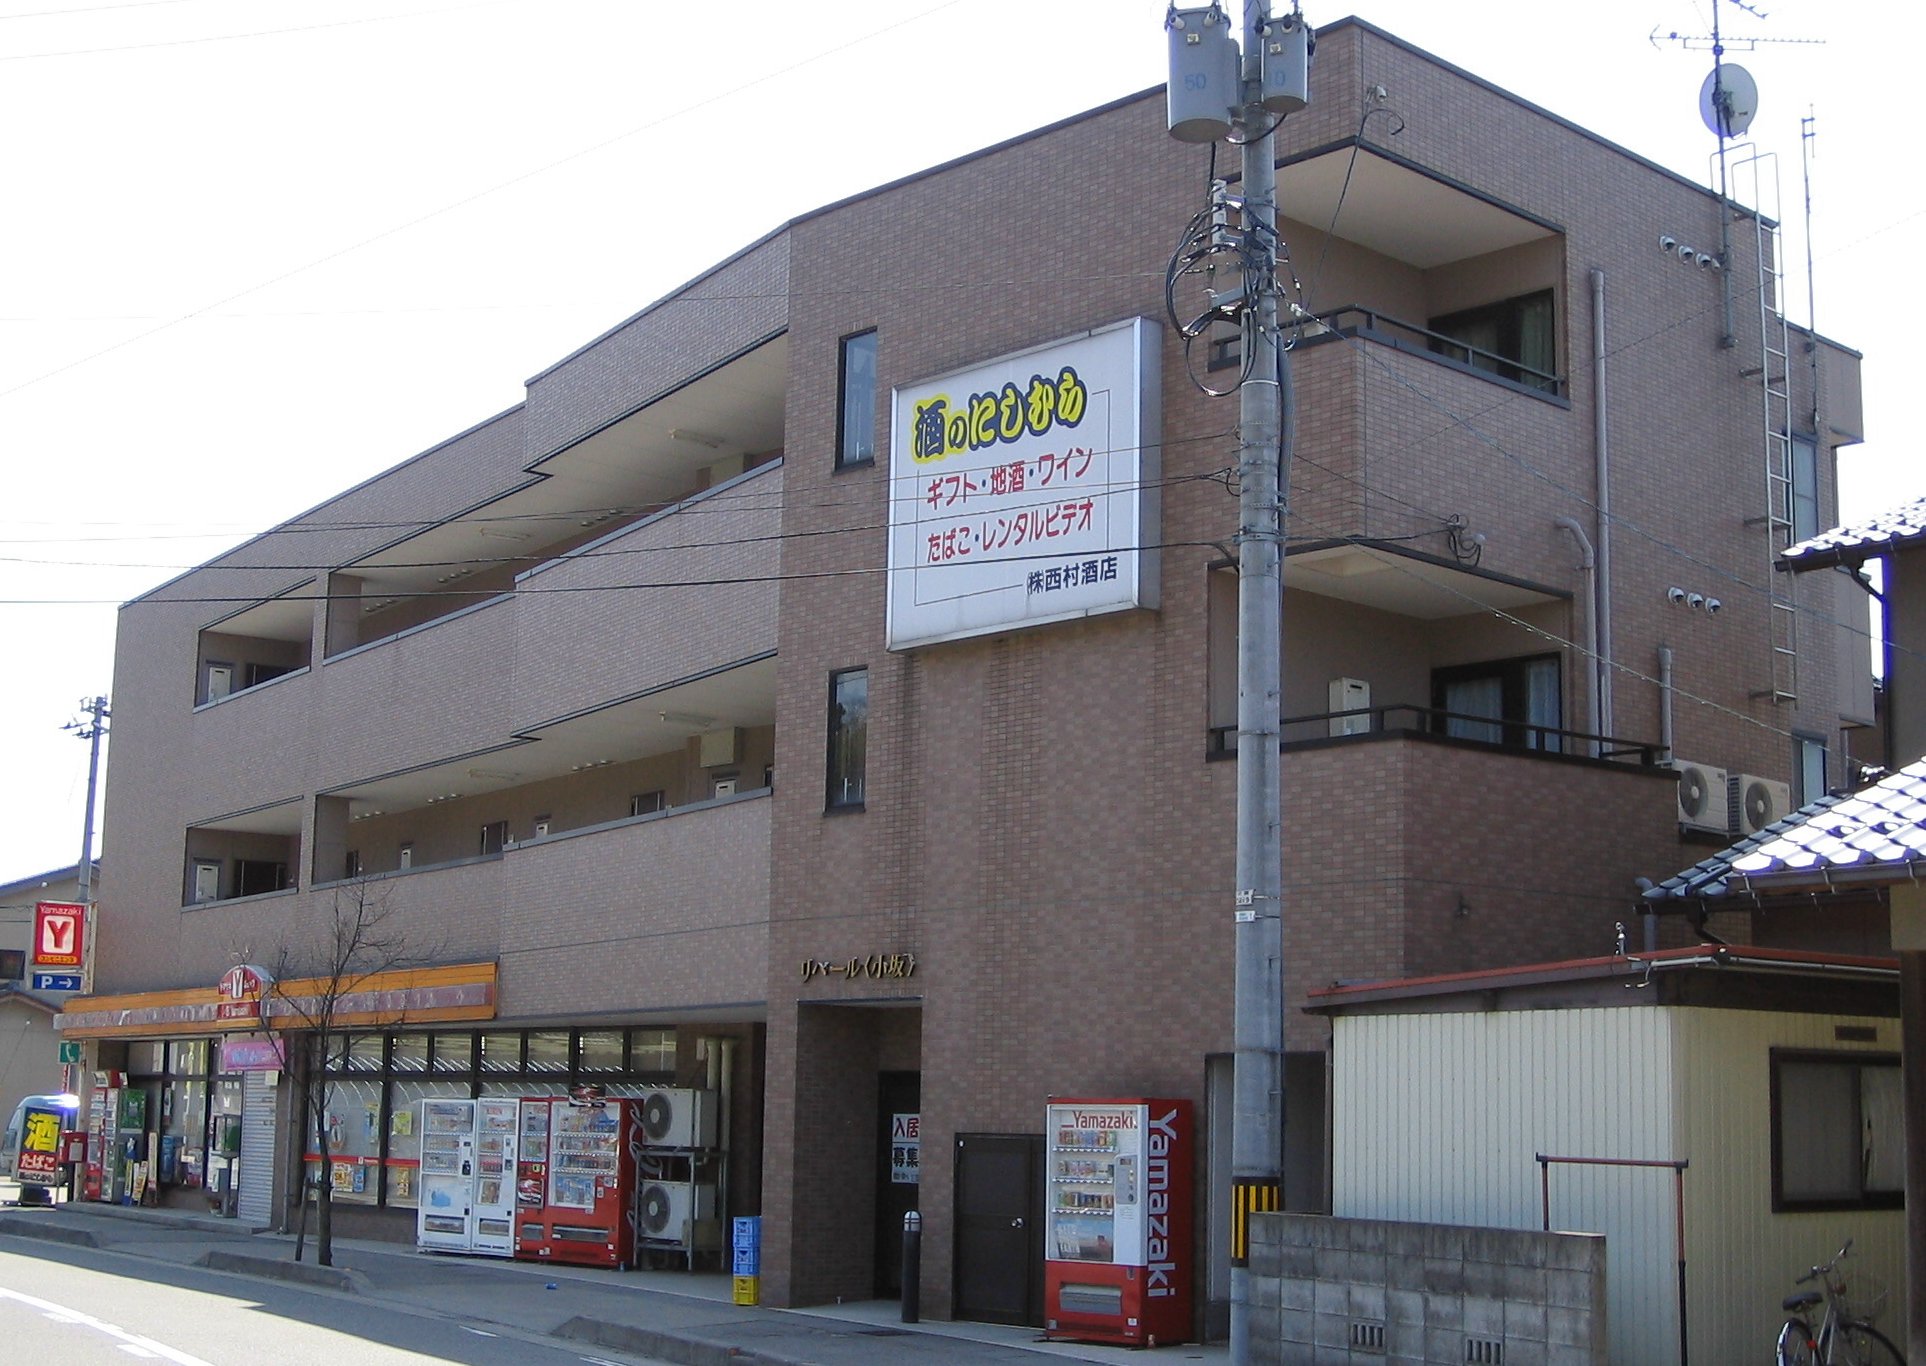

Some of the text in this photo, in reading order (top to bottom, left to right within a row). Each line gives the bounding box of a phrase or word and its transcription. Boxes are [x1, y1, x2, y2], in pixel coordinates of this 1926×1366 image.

[1184, 73, 1207, 91] 50
[912, 366, 1087, 463] 酒のにしむら
[927, 447, 1094, 511] ギフト・地酒・ワイン
[927, 498, 1094, 563] たばこ・レンタルビデオ
[40, 905, 82, 915] Yamazaki
[46, 920, 71, 949] Y
[41, 976, 53, 989] P
[894, 1117, 920, 1138] 入居
[1072, 1110, 1133, 1130] Yamazaki
[24, 1112, 61, 1153] 酒
[20, 1153, 55, 1171] たばこ
[893, 1146, 920, 1168] 募集
[1147, 1108, 1178, 1298] Yamazaki
